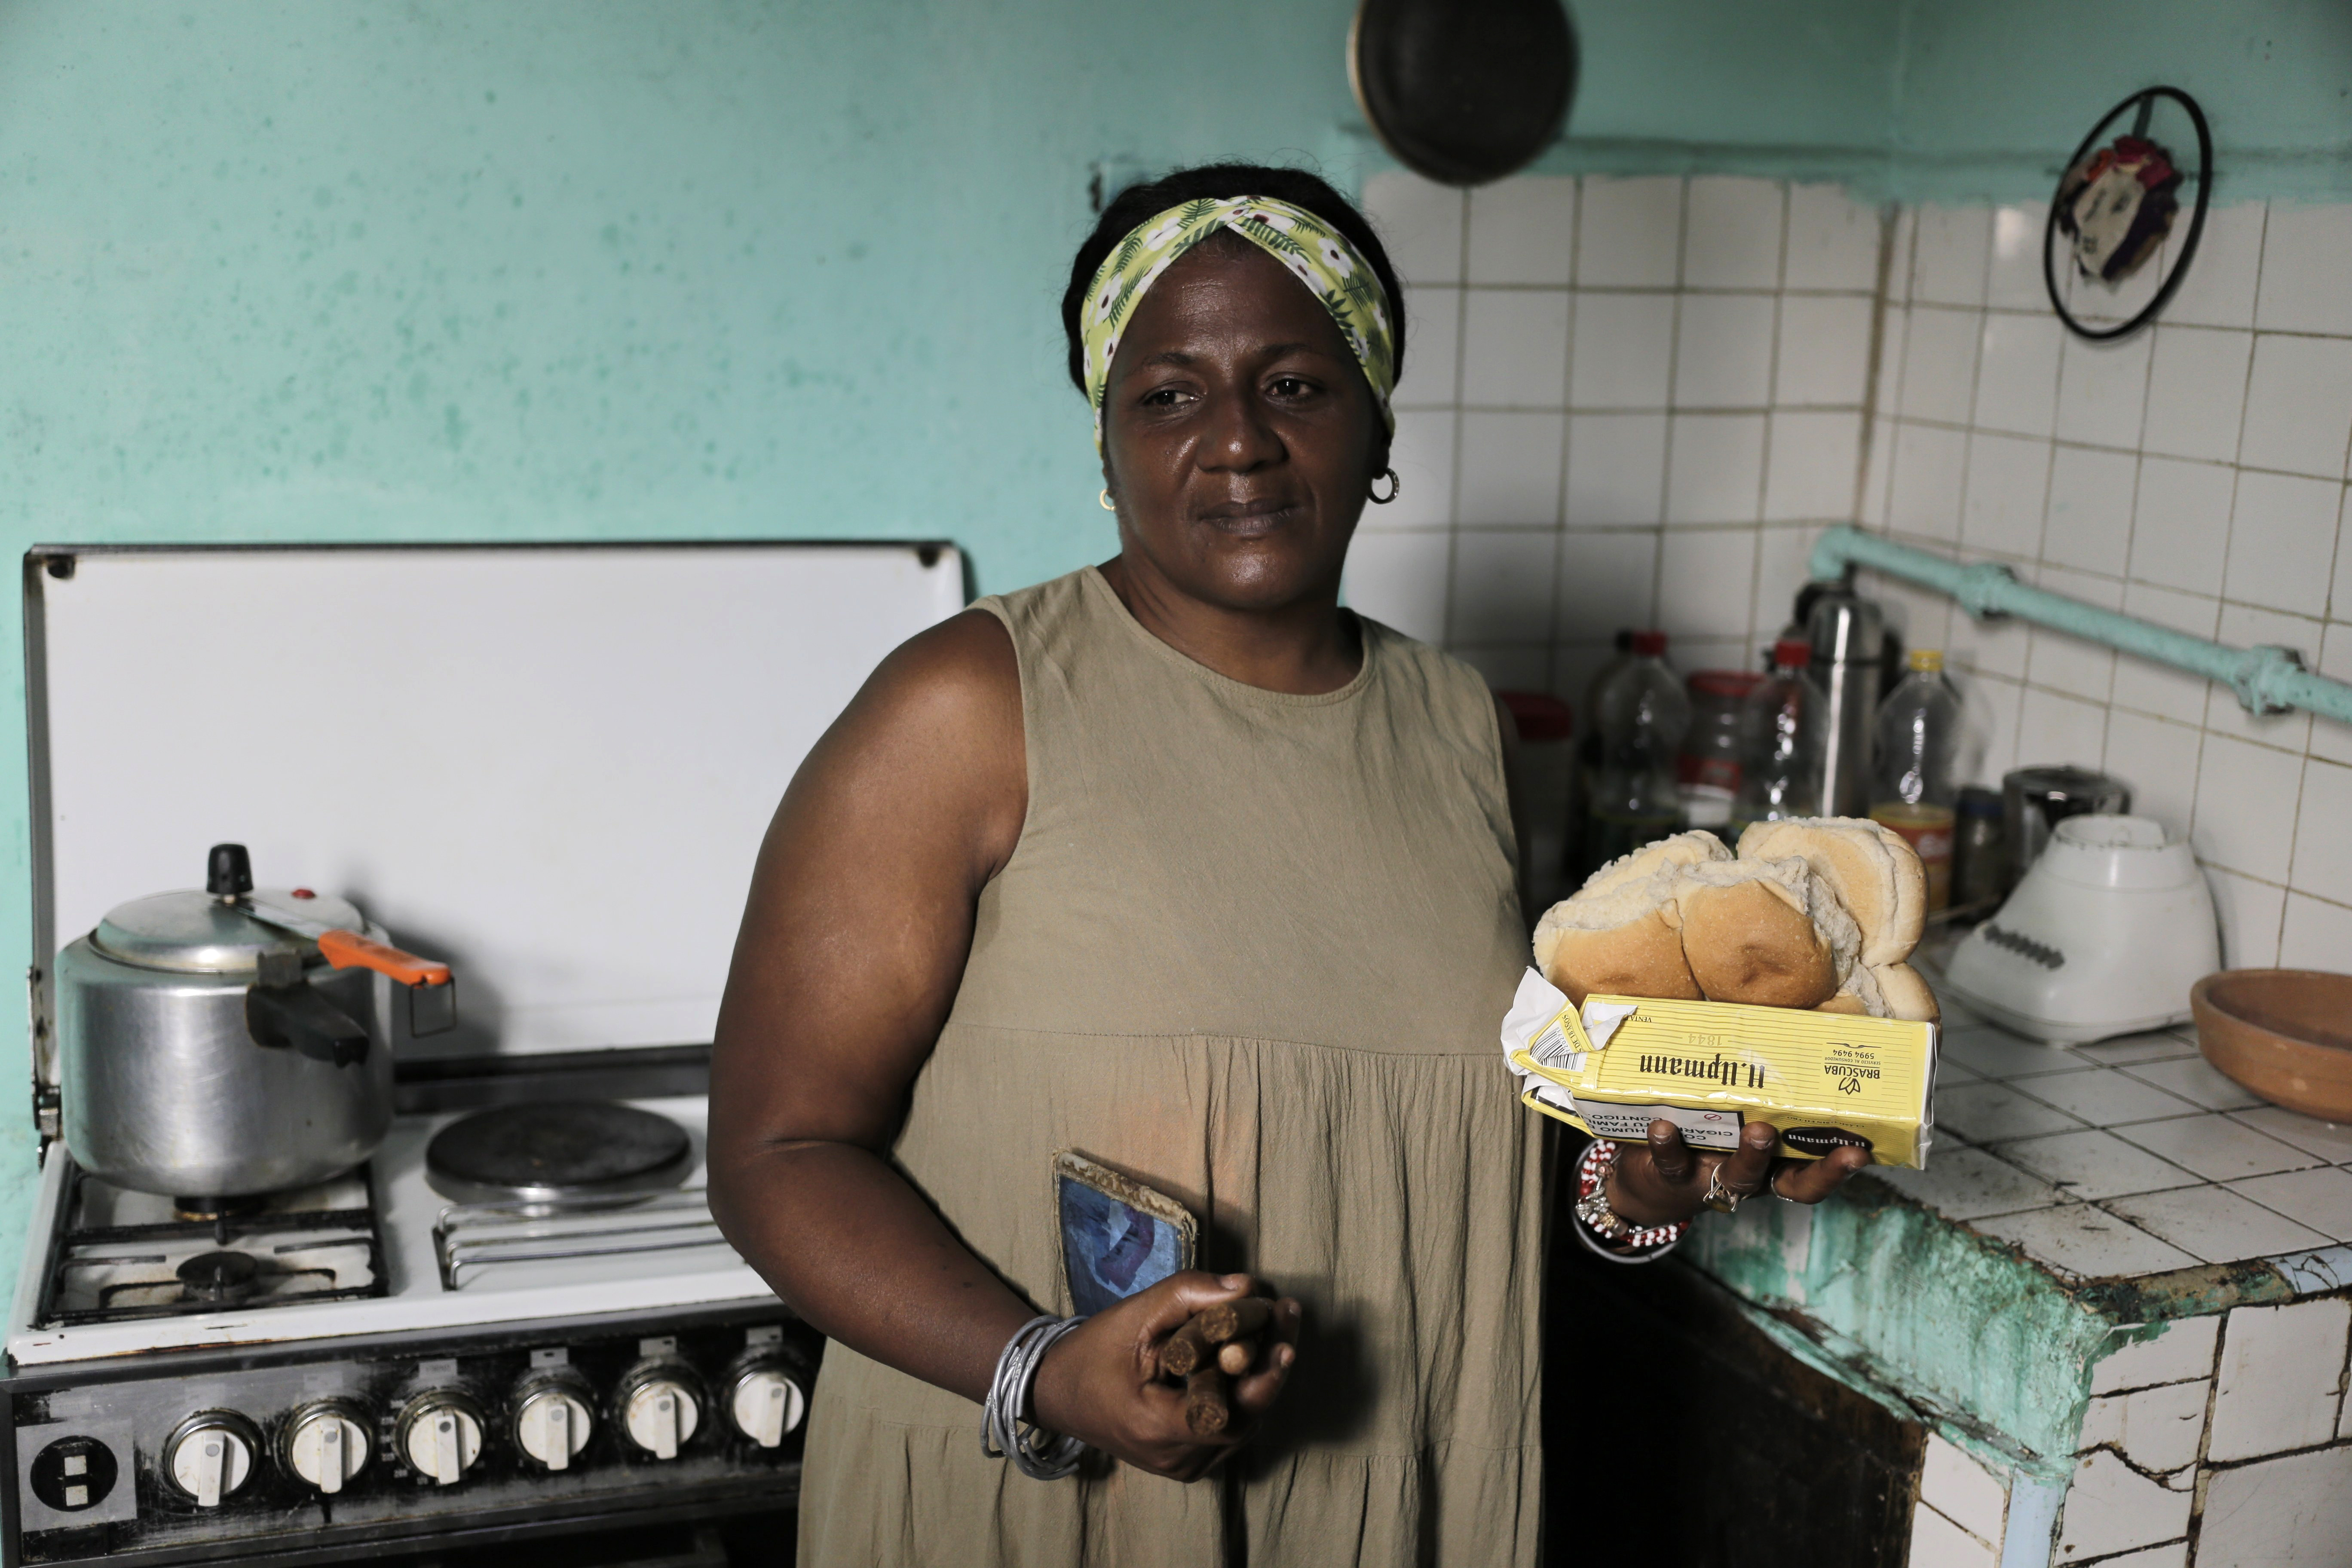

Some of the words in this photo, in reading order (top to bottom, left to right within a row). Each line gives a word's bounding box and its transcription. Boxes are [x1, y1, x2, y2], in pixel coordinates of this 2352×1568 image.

[1562, 1014, 1572, 1030] AÑOS
[1573, 1038, 1580, 1048] DE
[1688, 1033, 1722, 1046] 1844
[1824, 1065, 1880, 1079] BRASCUBA
